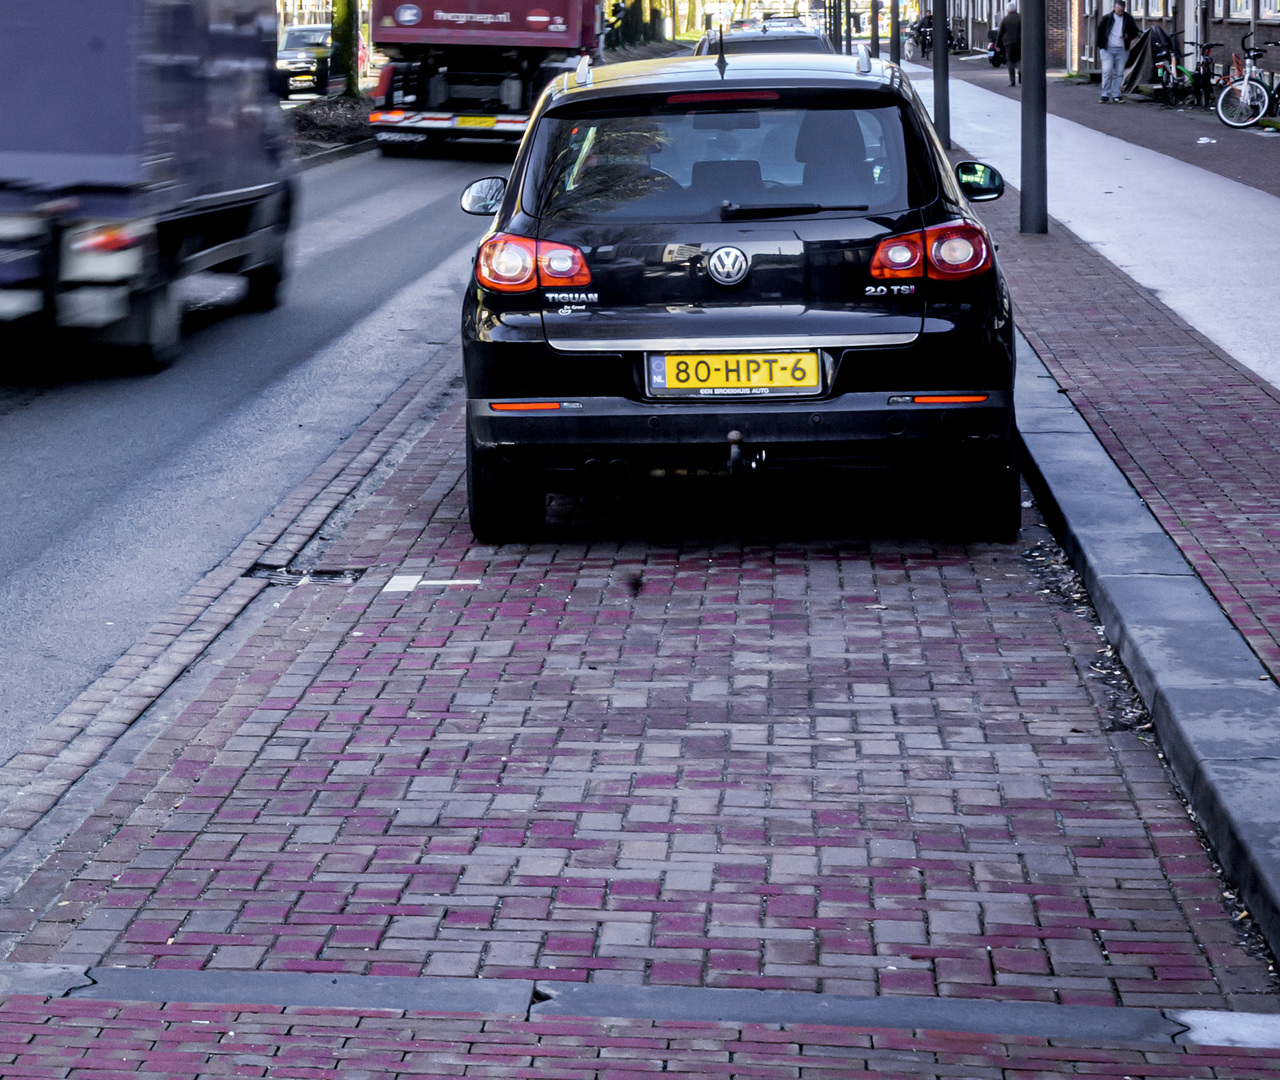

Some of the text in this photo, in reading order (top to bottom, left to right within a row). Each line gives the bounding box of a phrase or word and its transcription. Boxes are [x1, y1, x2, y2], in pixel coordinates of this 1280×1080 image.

[545, 293, 599, 303] TIGUAN
[675, 358, 807, 383] 80-HPT-6
[653, 375, 665, 383] NL
